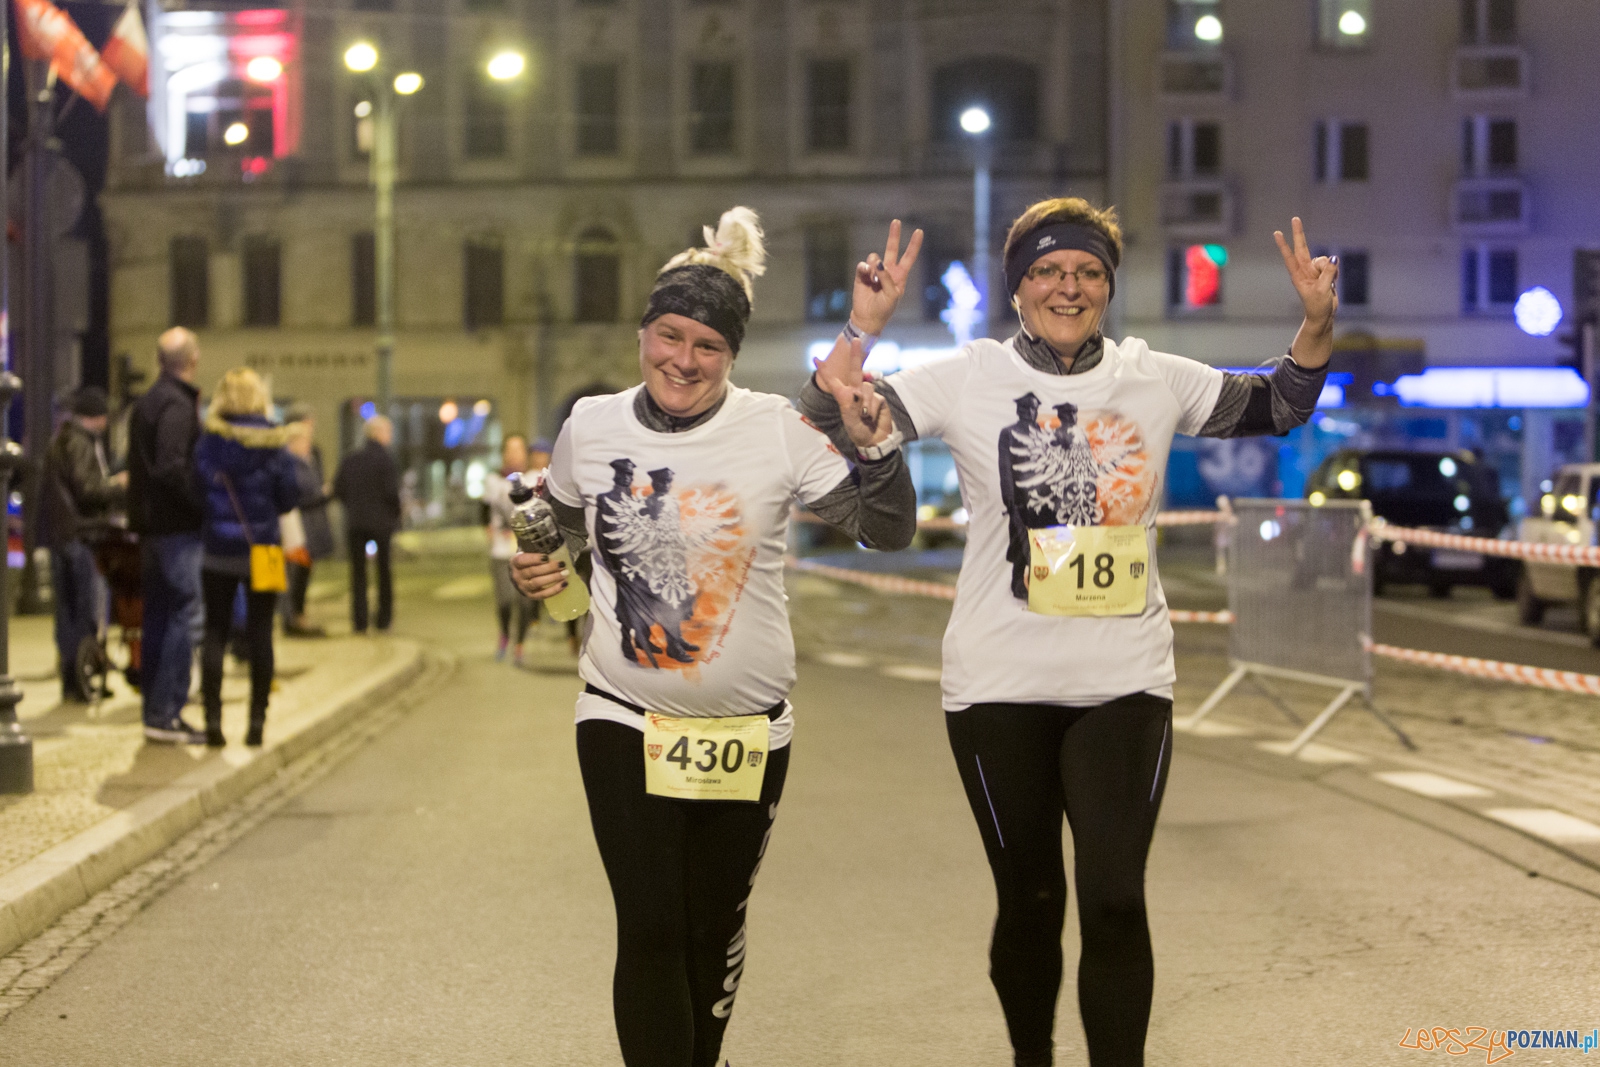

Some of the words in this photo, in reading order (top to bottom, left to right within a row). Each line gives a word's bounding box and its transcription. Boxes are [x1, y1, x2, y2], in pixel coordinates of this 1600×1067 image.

[1069, 553, 1115, 589] 18
[1075, 594, 1106, 602] Marzena
[666, 736, 744, 773] 430
